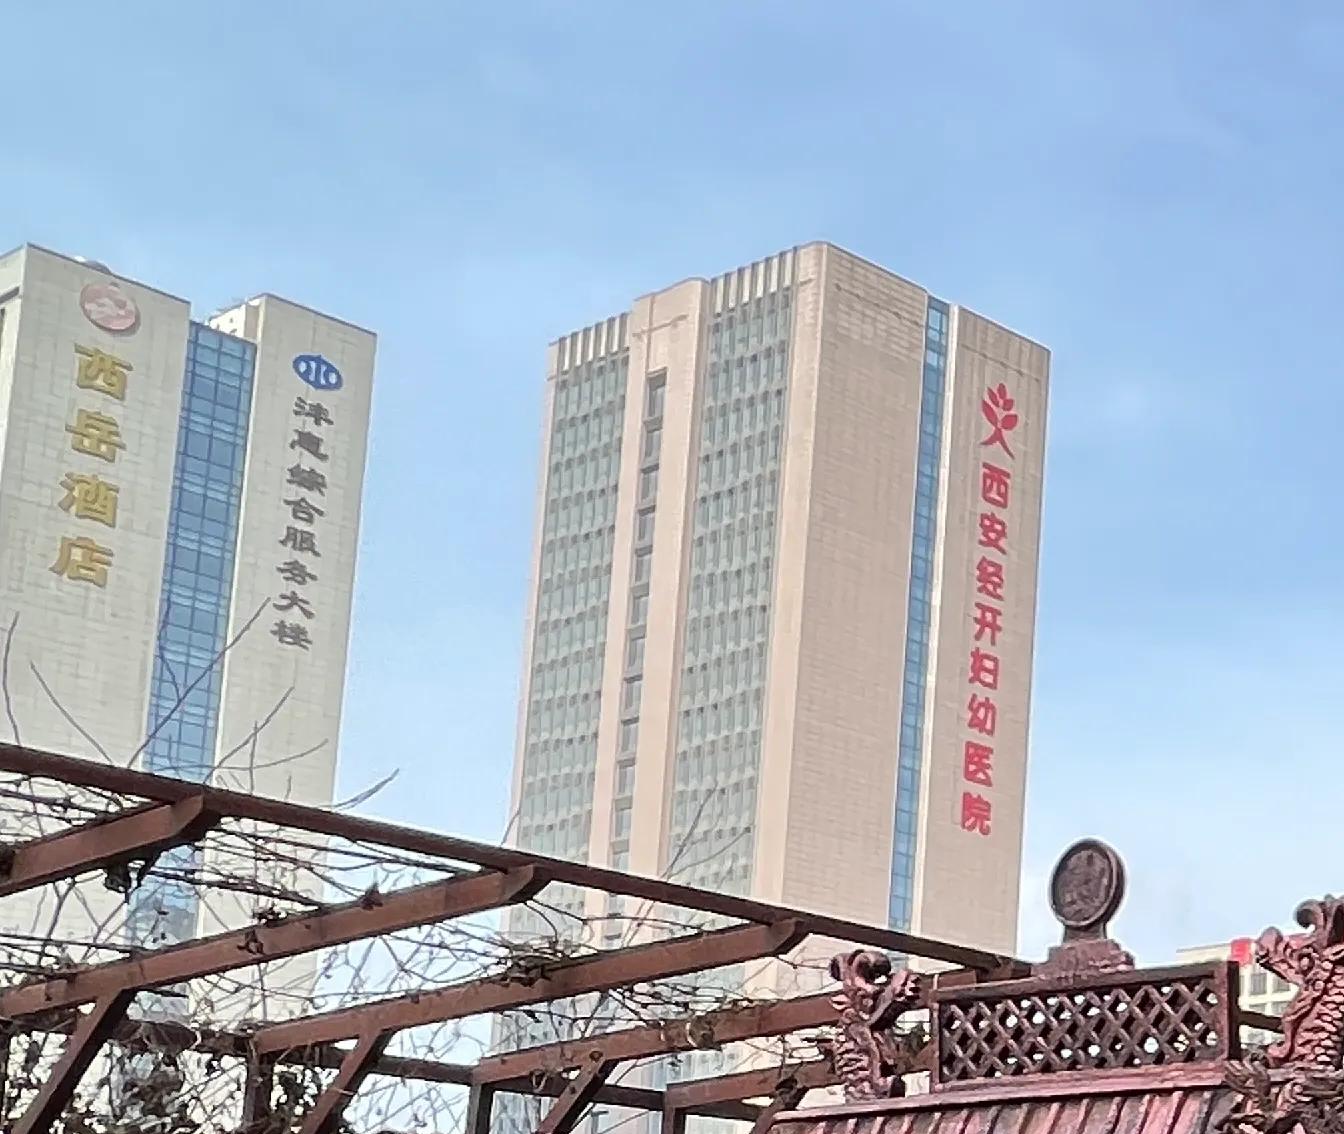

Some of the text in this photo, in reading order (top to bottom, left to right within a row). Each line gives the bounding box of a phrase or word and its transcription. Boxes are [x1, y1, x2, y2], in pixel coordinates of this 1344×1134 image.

[49, 342, 133, 588] 西岳酒店
[960, 462, 1011, 837] 西安经开妇幼医院
